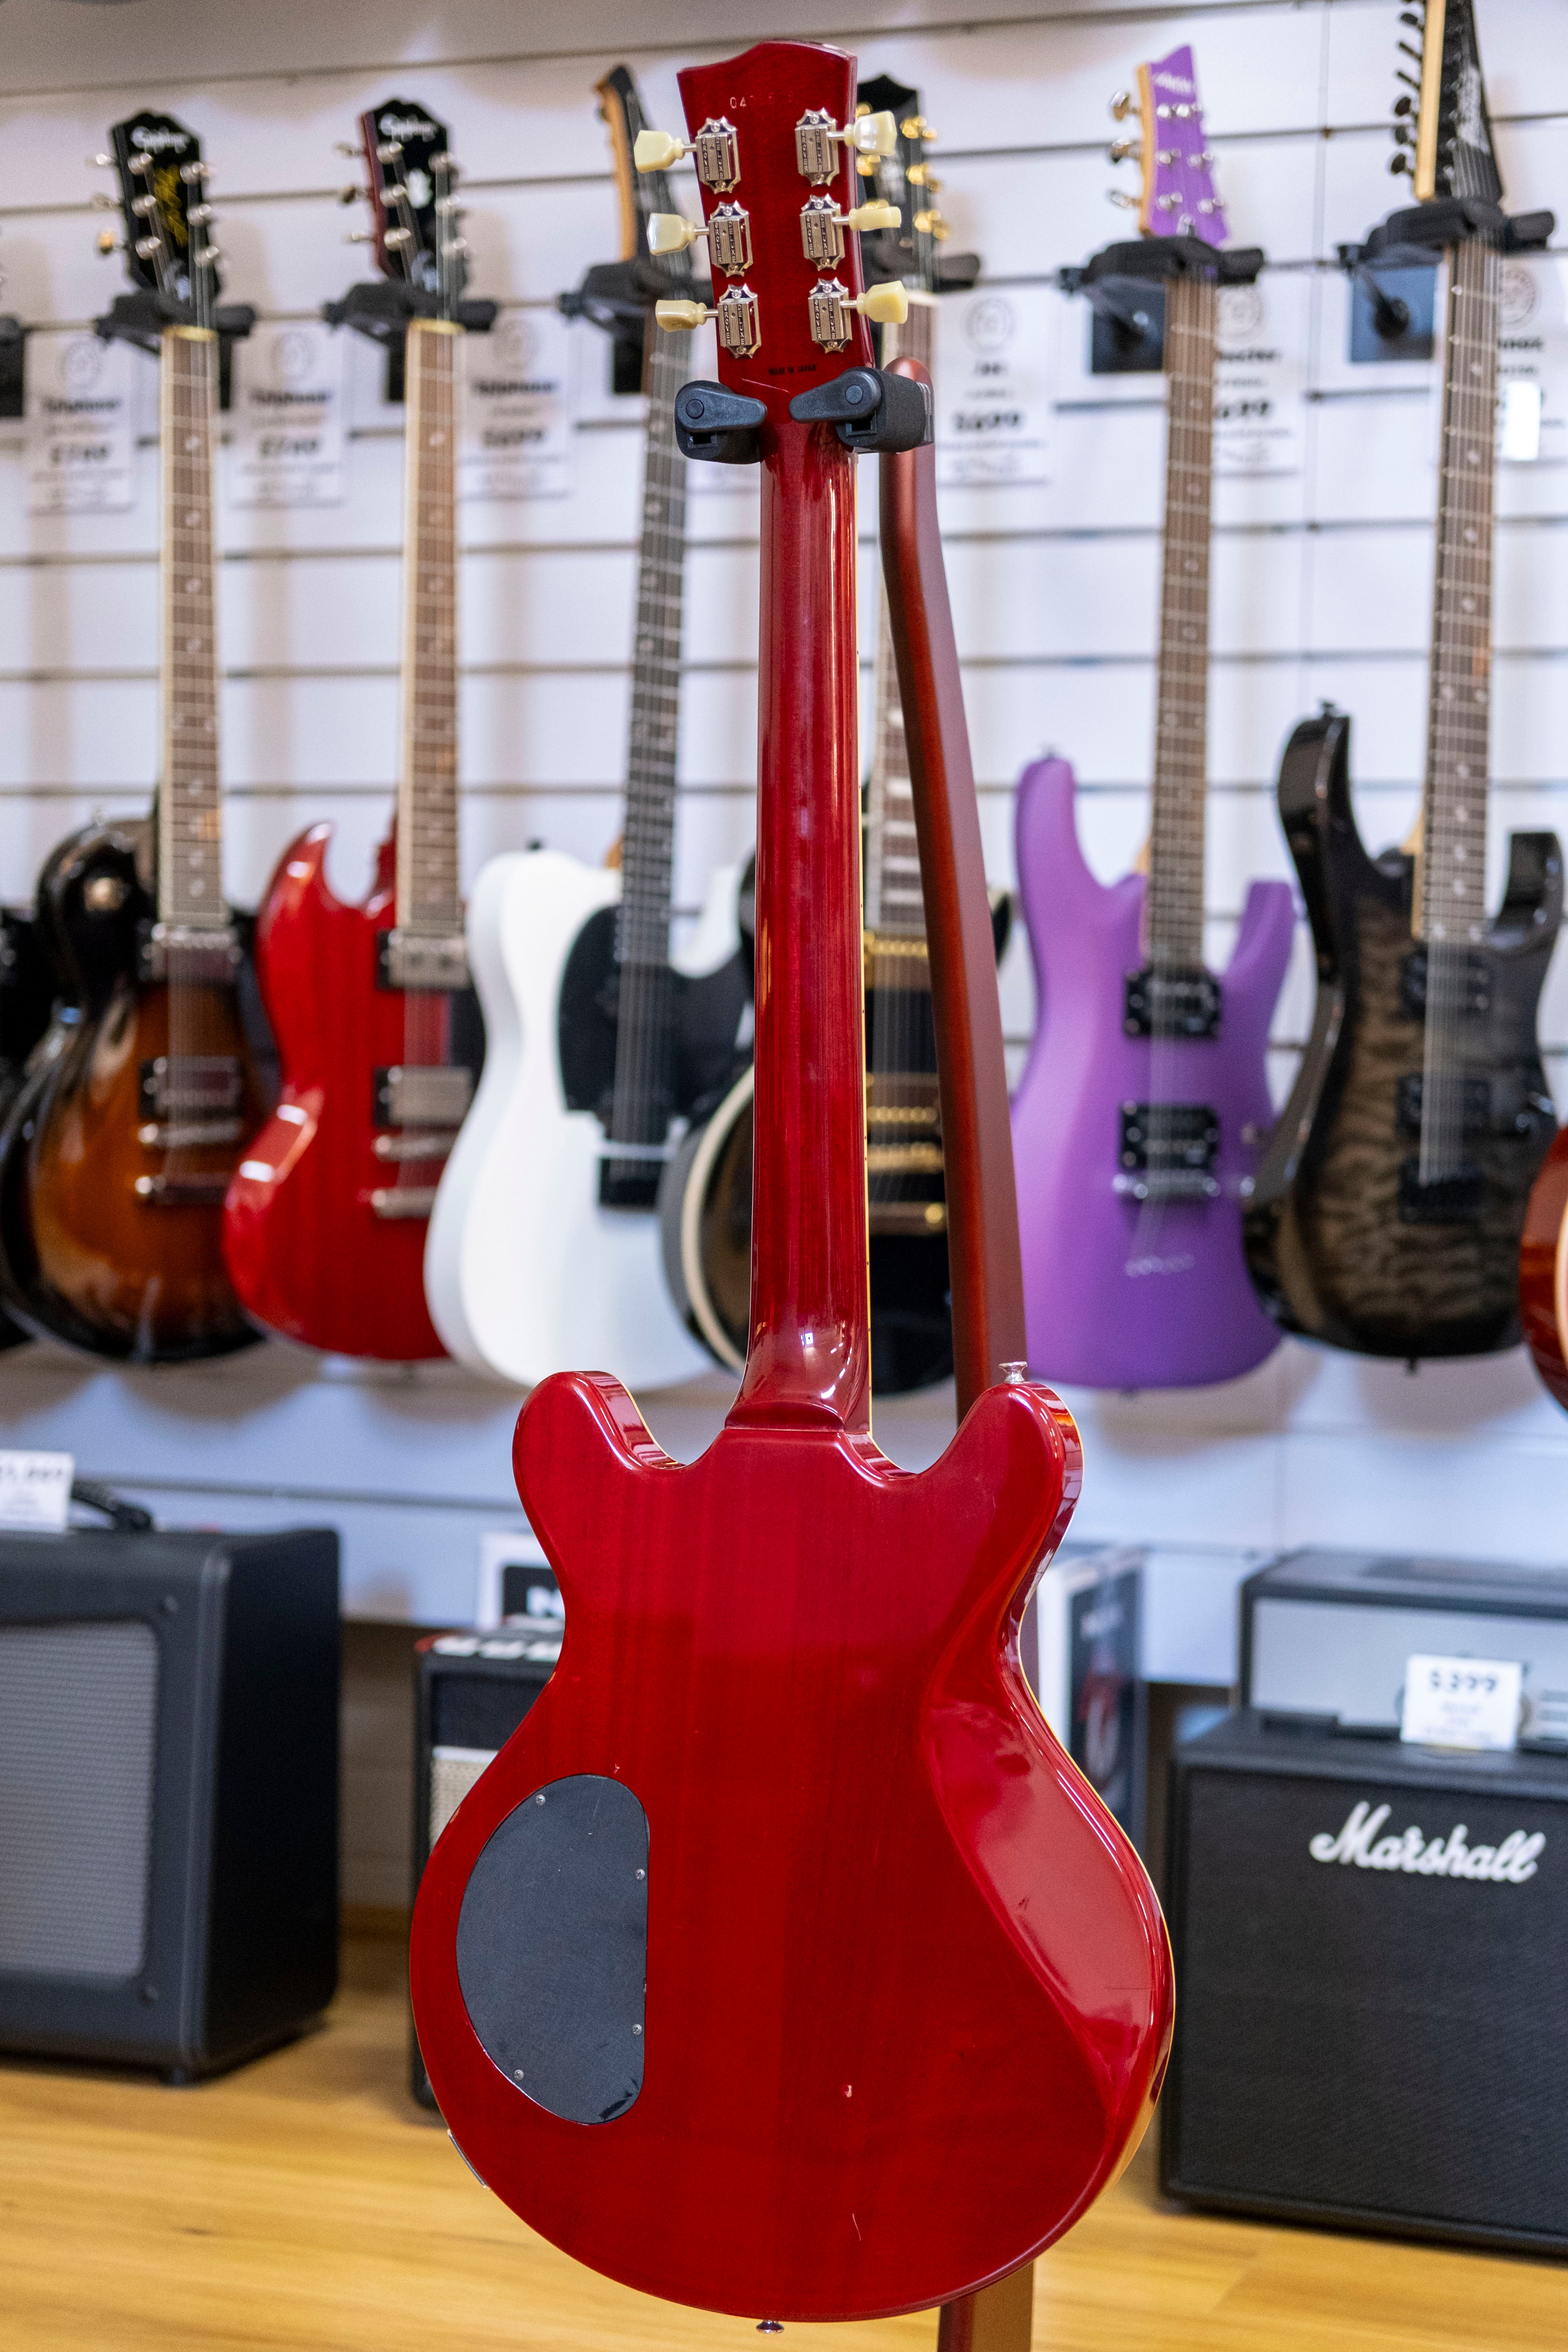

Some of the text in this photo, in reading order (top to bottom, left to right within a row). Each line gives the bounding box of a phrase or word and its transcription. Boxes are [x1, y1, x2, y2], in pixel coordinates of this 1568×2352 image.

[702, 138, 710, 180] GROVER
[716, 137, 724, 179] DELUXE
[801, 130, 809, 173] GROVER
[815, 129, 824, 172] DELUXE
[714, 222, 722, 263] GROVER
[728, 221, 737, 262] DELUXE
[806, 215, 815, 257] GROVER
[820, 215, 828, 257] DELUXE
[738, 304, 746, 345] DELUXE
[1309, 1801, 1547, 1884] Marshall
